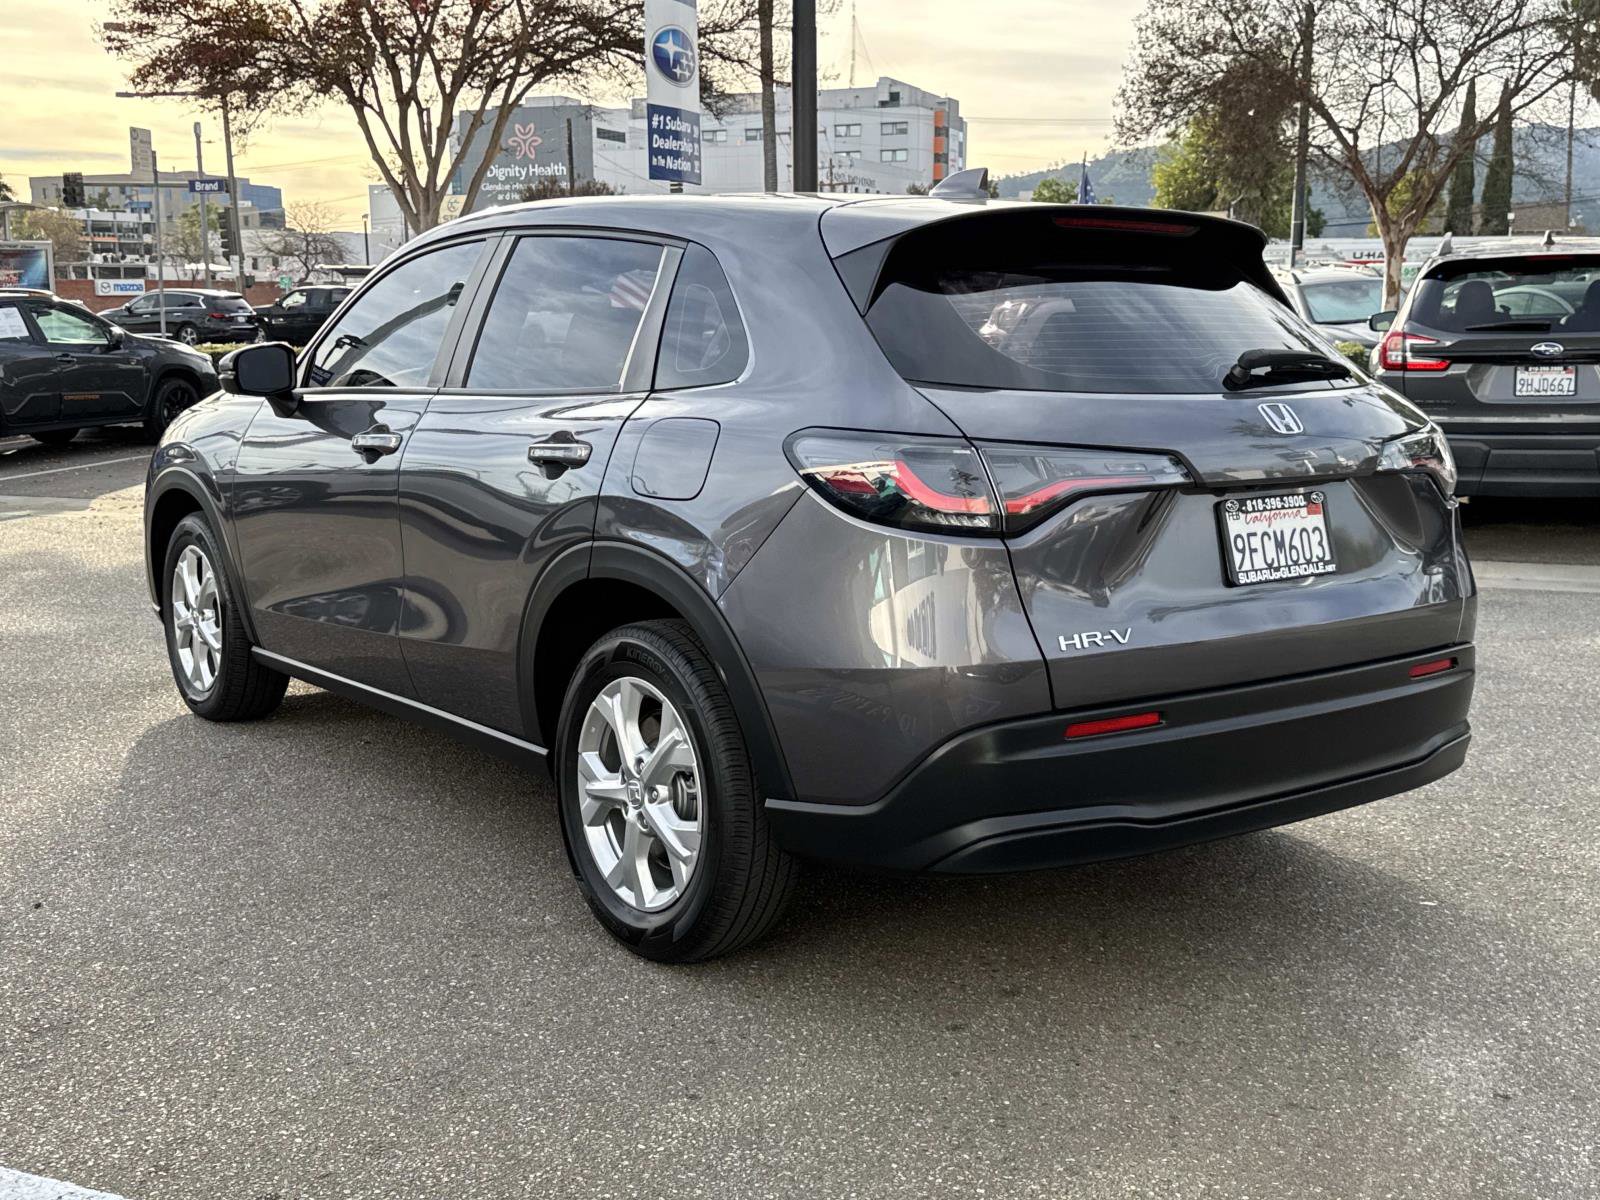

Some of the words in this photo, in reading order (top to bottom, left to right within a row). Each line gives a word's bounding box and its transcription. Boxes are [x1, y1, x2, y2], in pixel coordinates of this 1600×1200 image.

[652, 113, 664, 130] #1
[666, 115, 692, 134] Subaru
[652, 134, 693, 156] Dealership
[487, 163, 528, 181] Dignity
[529, 162, 567, 176] Health
[666, 155, 692, 172] Nation
[194, 181, 219, 191] Brand
[1244, 508, 1308, 529] California
[1233, 526, 1326, 571] 9FCM603
[1058, 627, 1132, 651] HR-V
